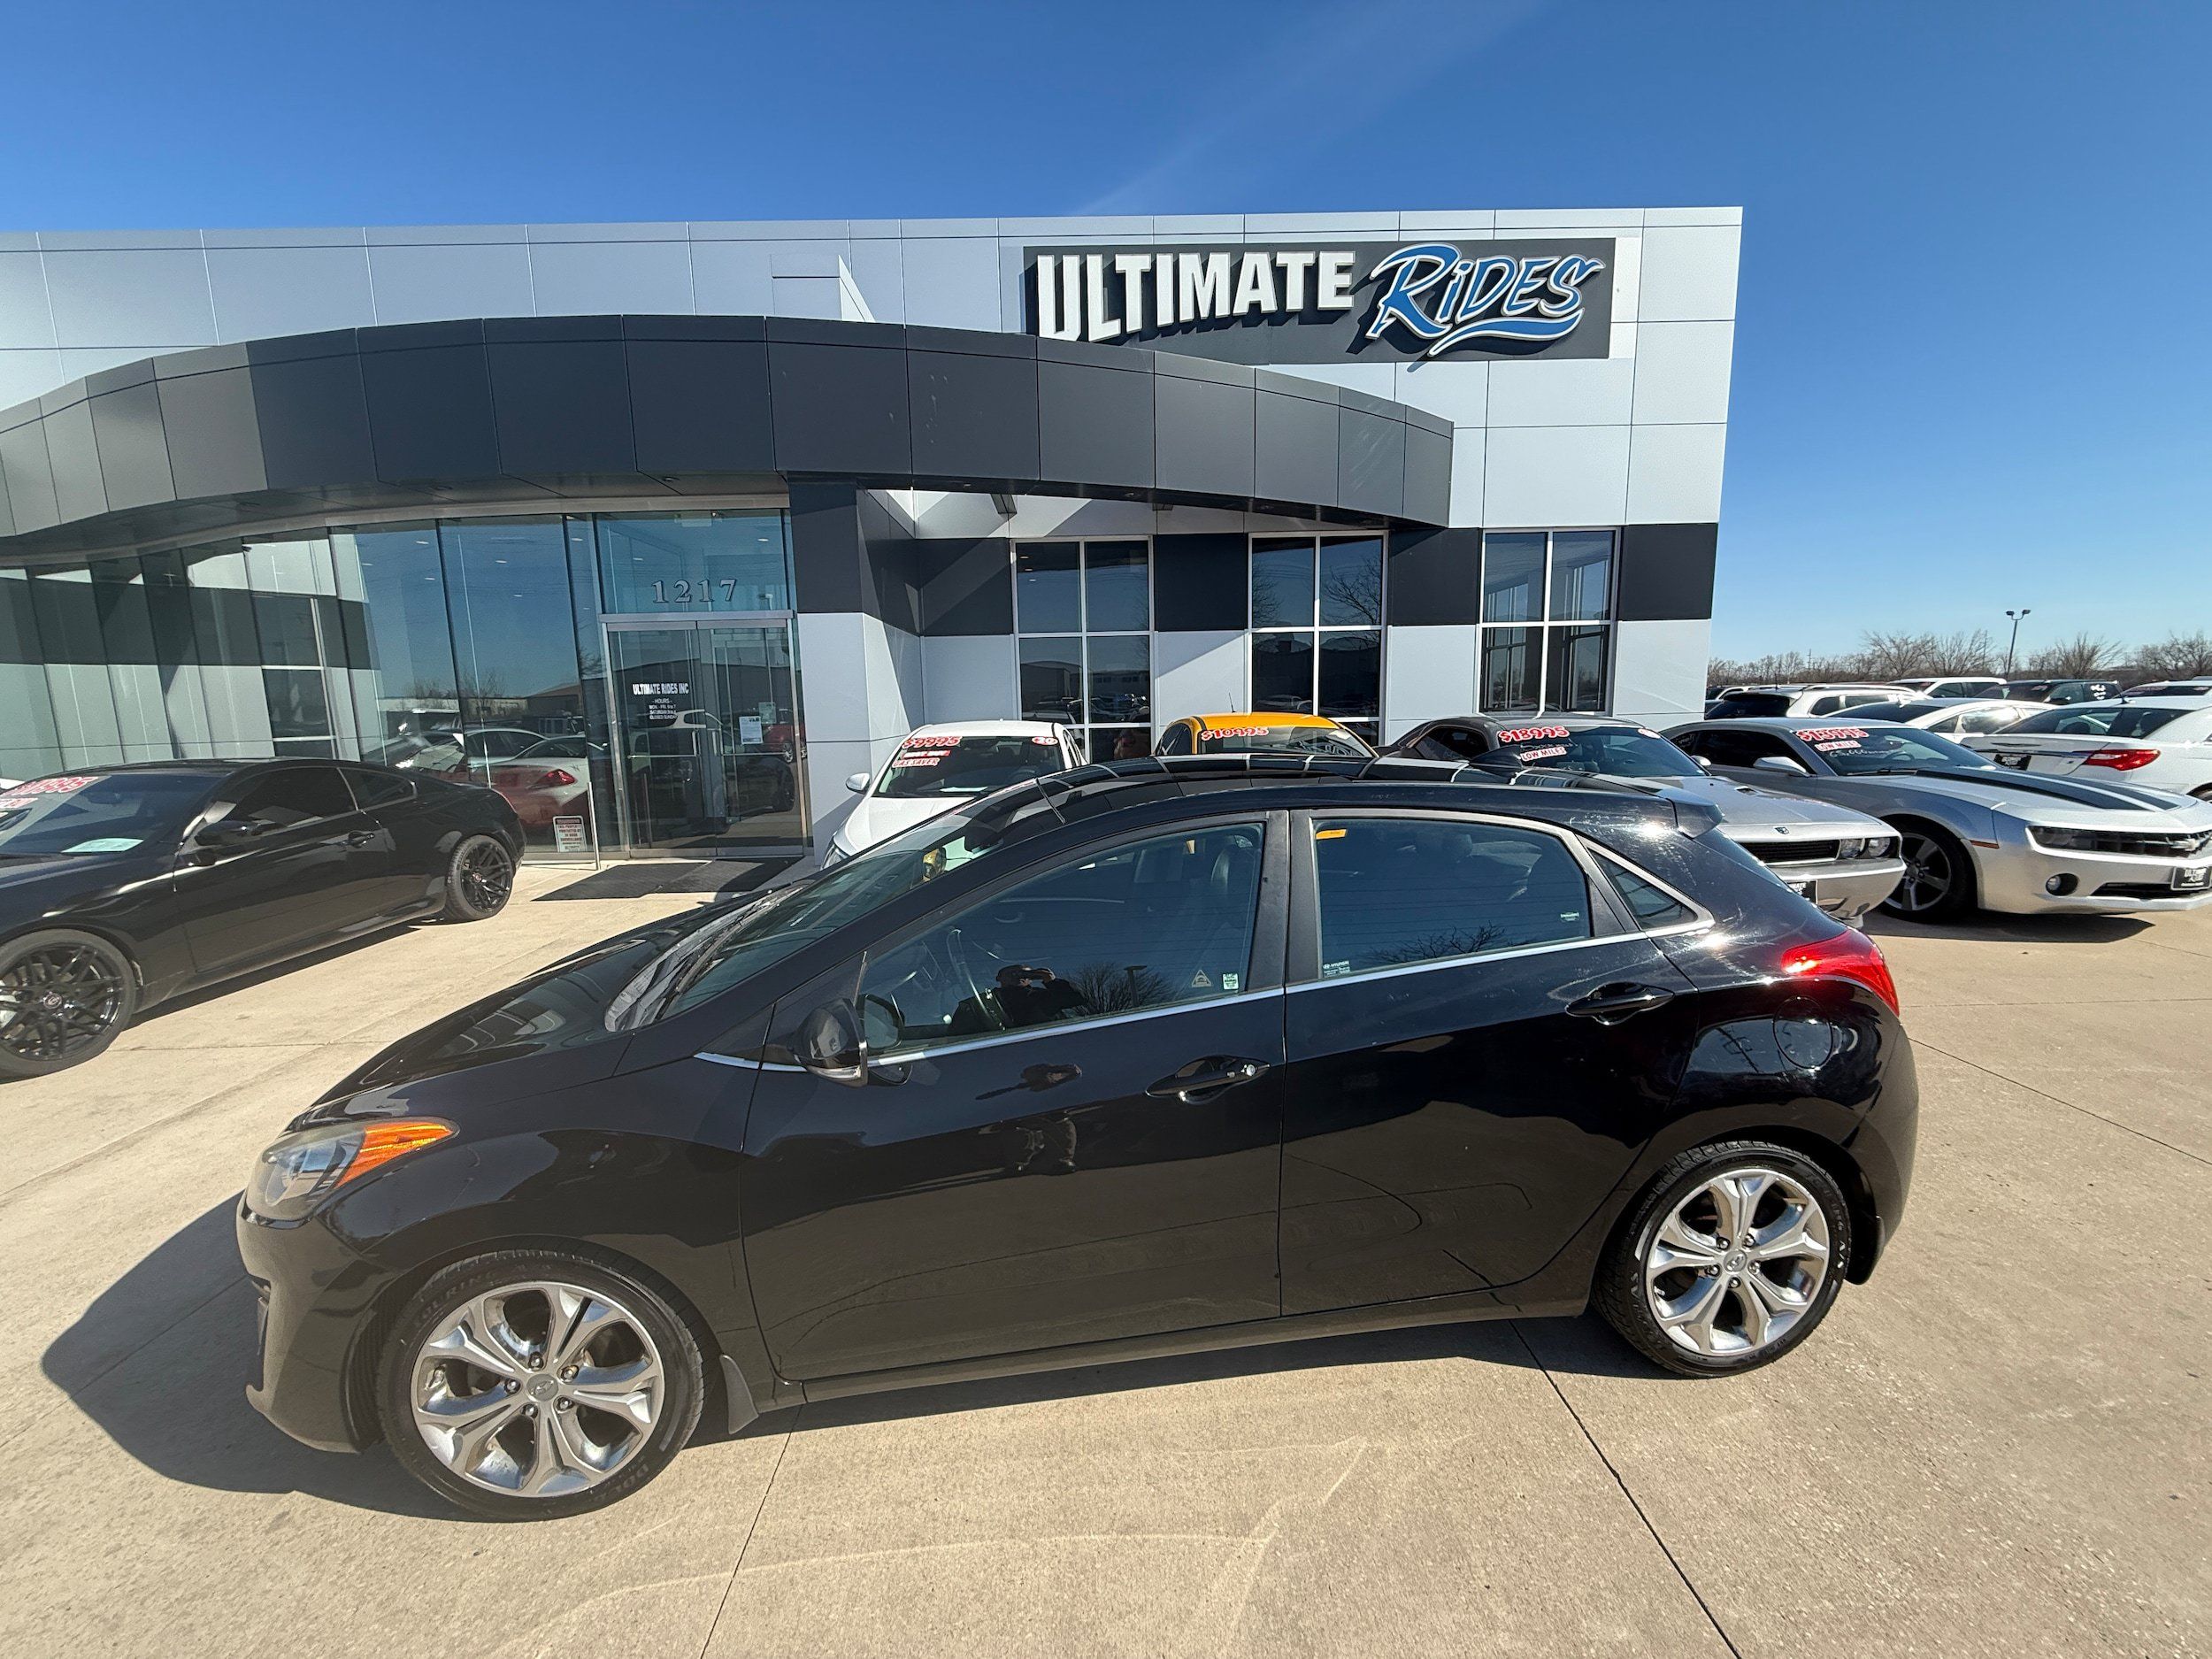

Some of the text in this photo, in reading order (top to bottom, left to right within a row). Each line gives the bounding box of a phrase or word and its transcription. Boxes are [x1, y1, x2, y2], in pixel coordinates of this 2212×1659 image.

[1037, 250, 1356, 342] ULTIMATE
[652, 579, 737, 603] 1217
[633, 683, 689, 695] ULTIMATE RIDES INC
[1202, 726, 1269, 741] $10995
[1498, 726, 1571, 742] $18995
[1523, 747, 1565, 760] LOW MILES
[910, 758, 938, 767] SAVER
